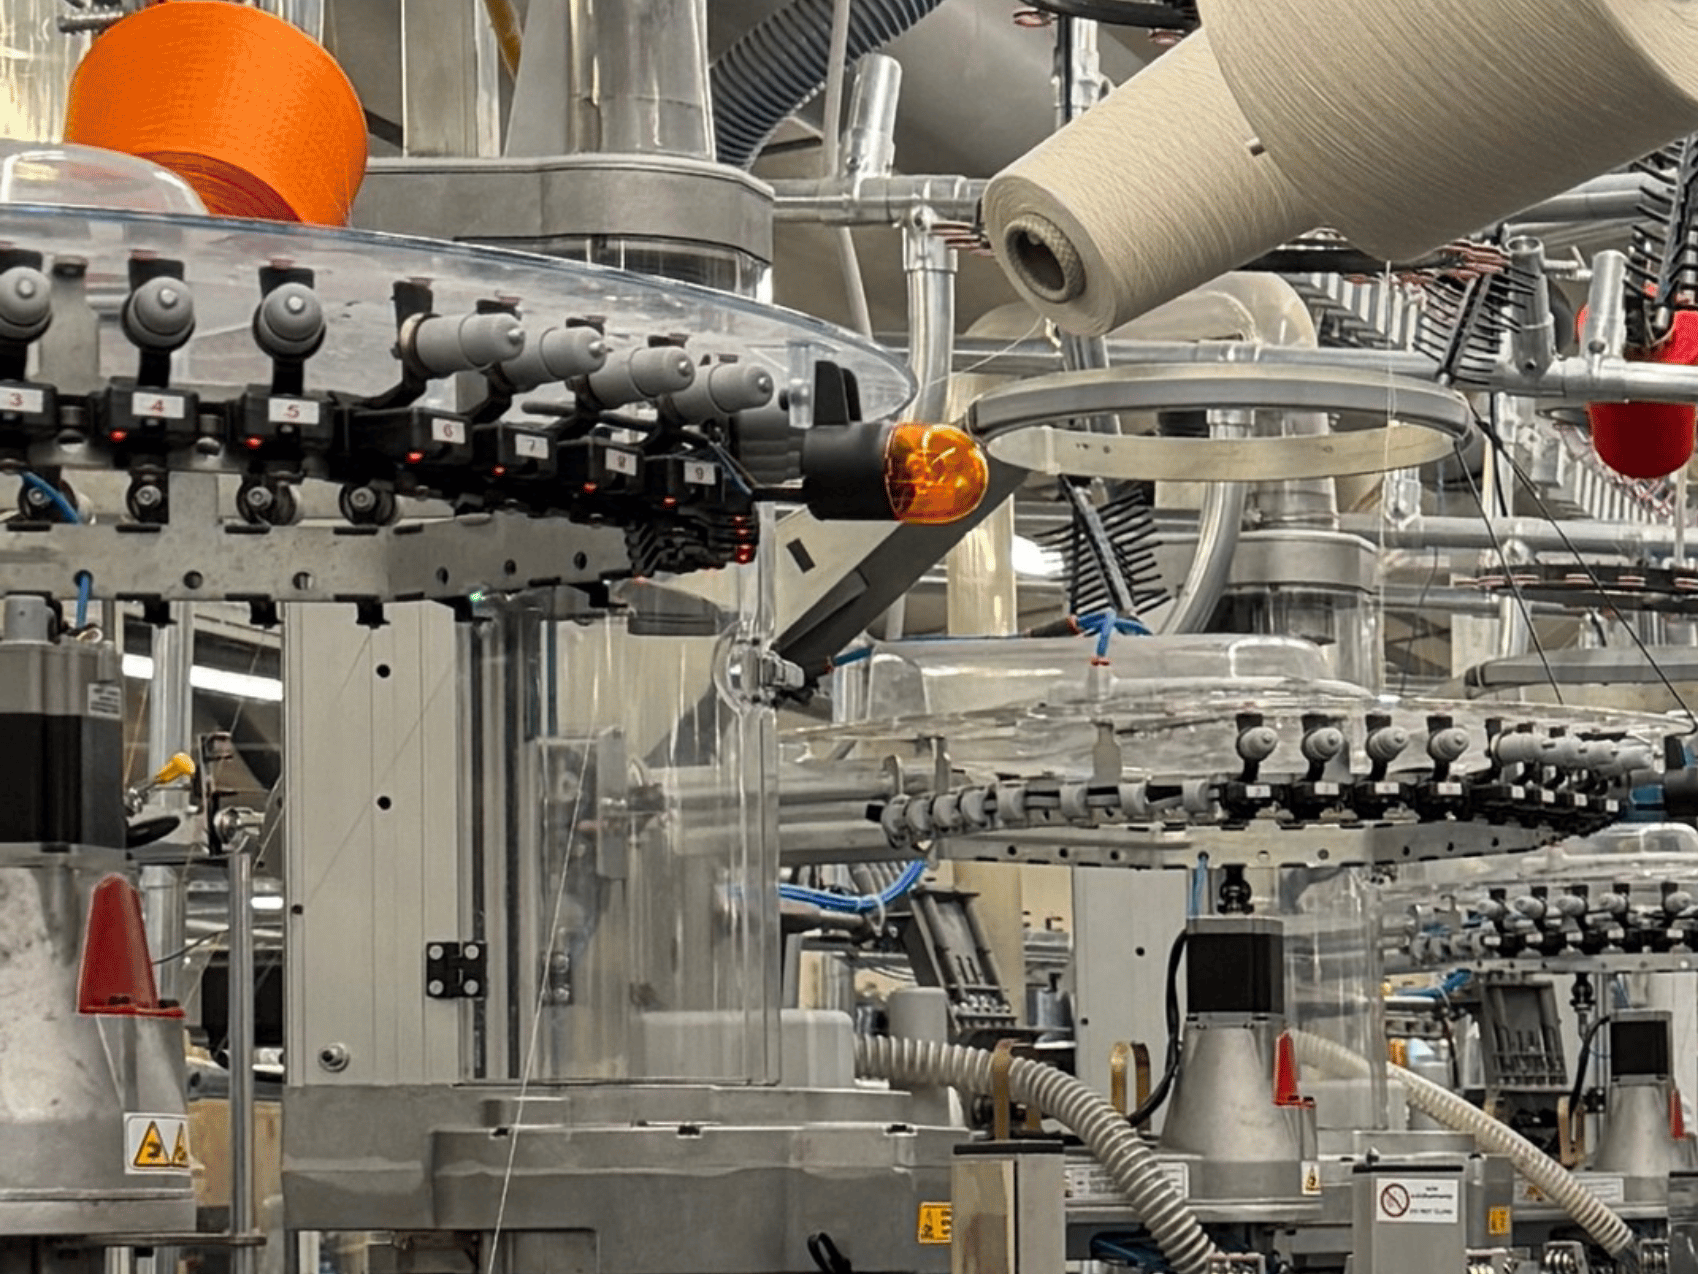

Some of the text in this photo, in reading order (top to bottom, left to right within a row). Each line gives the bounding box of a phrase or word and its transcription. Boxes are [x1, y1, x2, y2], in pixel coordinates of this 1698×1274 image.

[10, 393, 23, 406] 3
[151, 399, 164, 413] 4
[285, 404, 300, 419] 5
